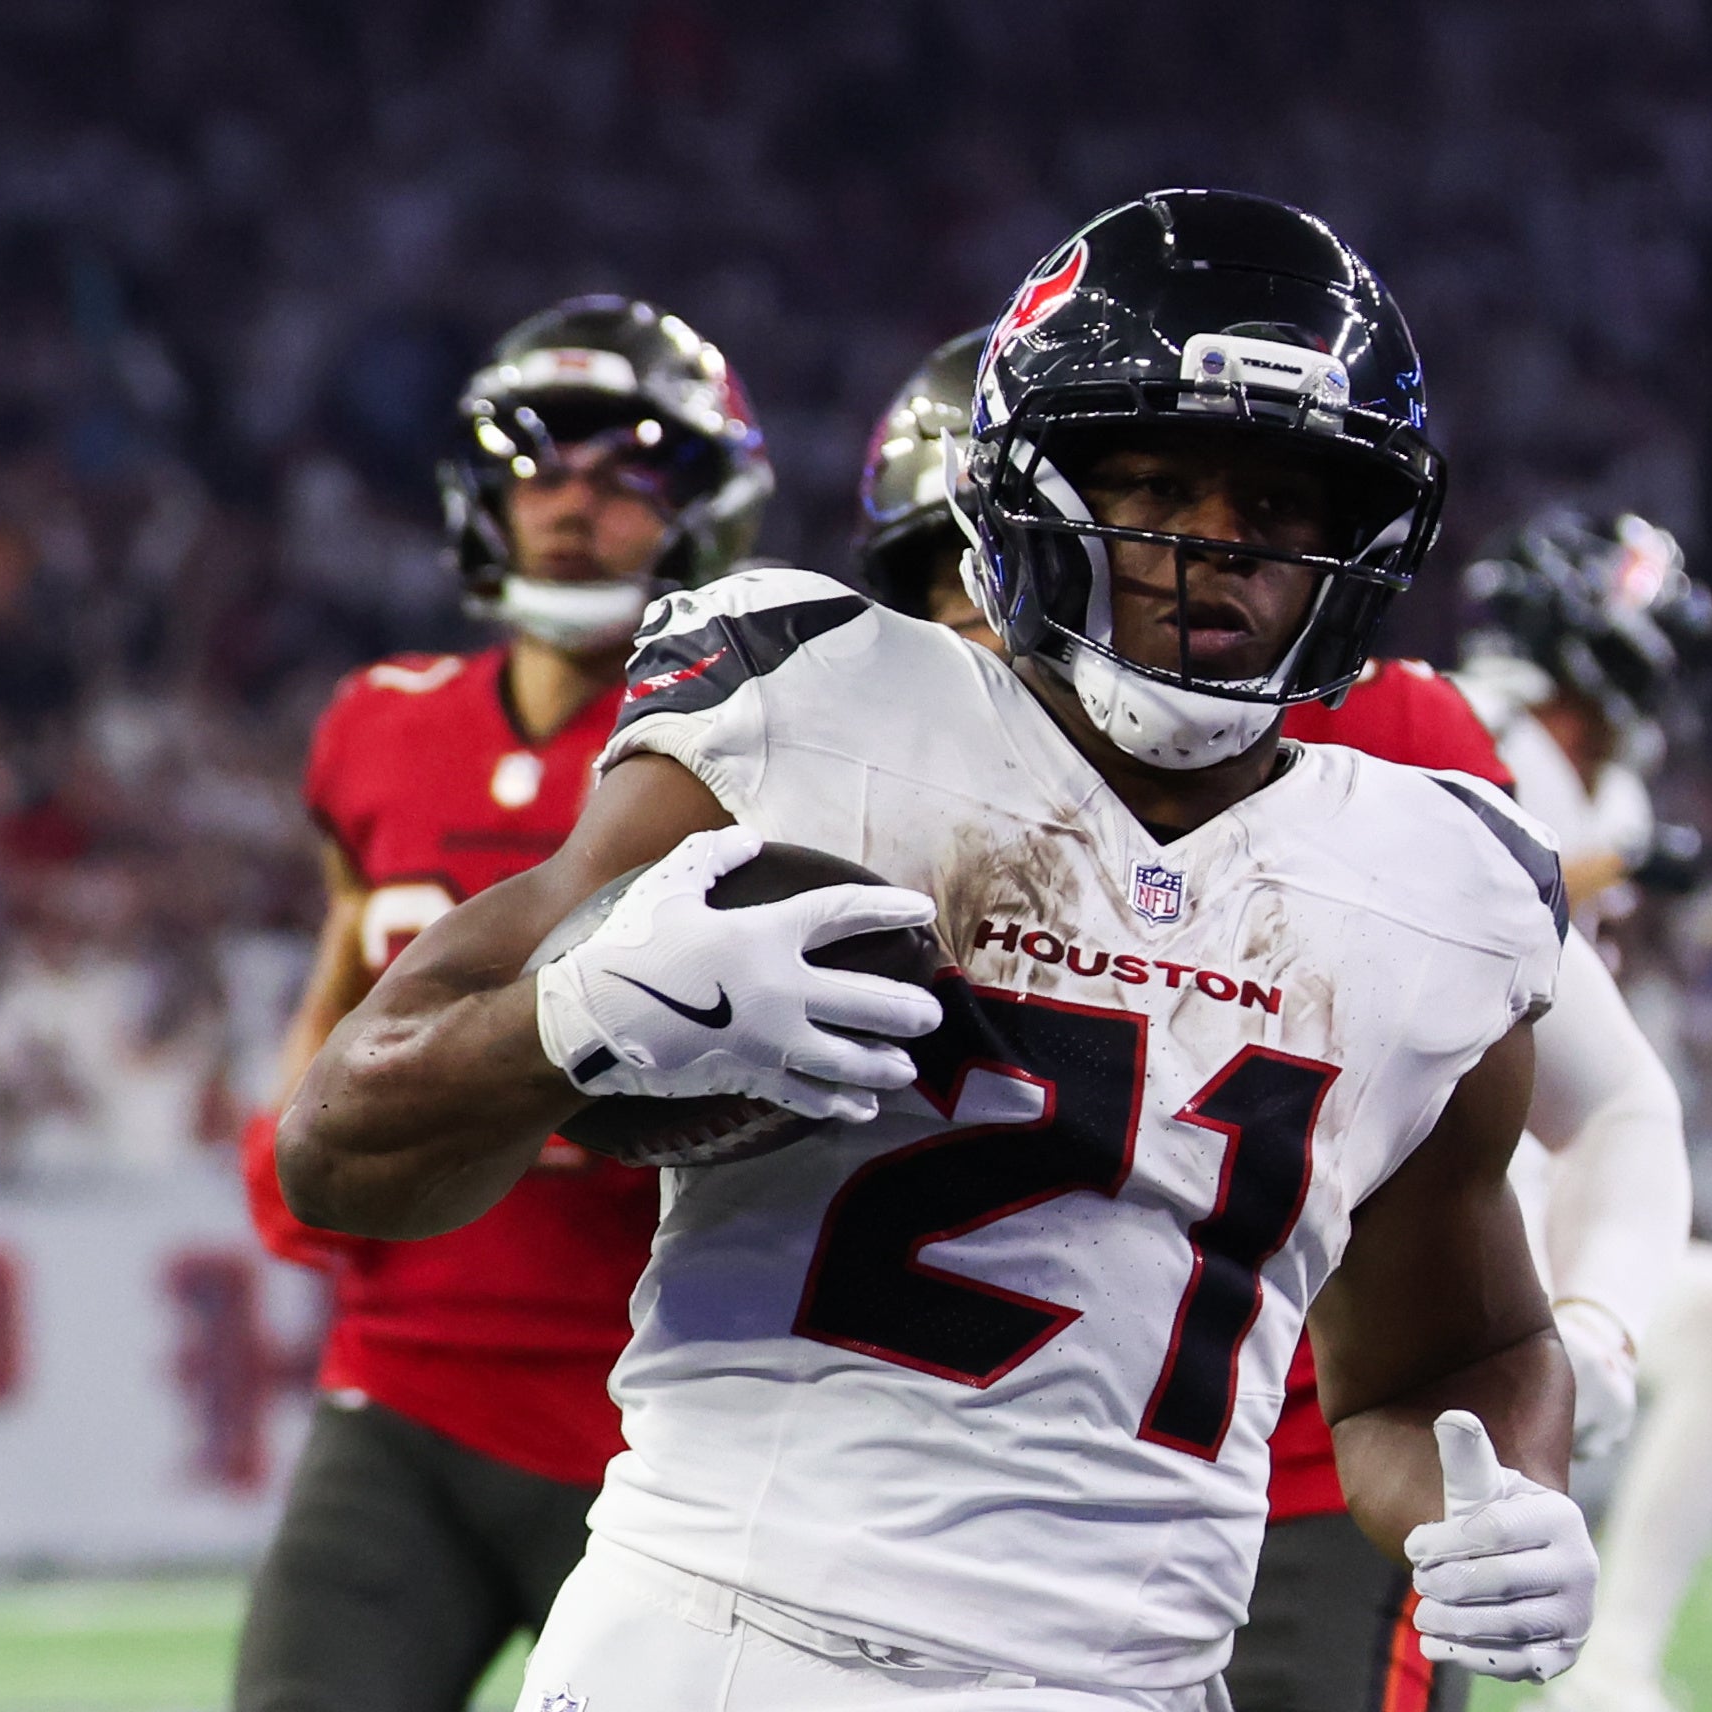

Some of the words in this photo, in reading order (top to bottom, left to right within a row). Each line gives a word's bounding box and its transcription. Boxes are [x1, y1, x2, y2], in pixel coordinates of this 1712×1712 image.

[1137, 885, 1175, 914] NFL
[973, 919, 1283, 1014] HOUSTON
[791, 967, 1343, 1464] 21
